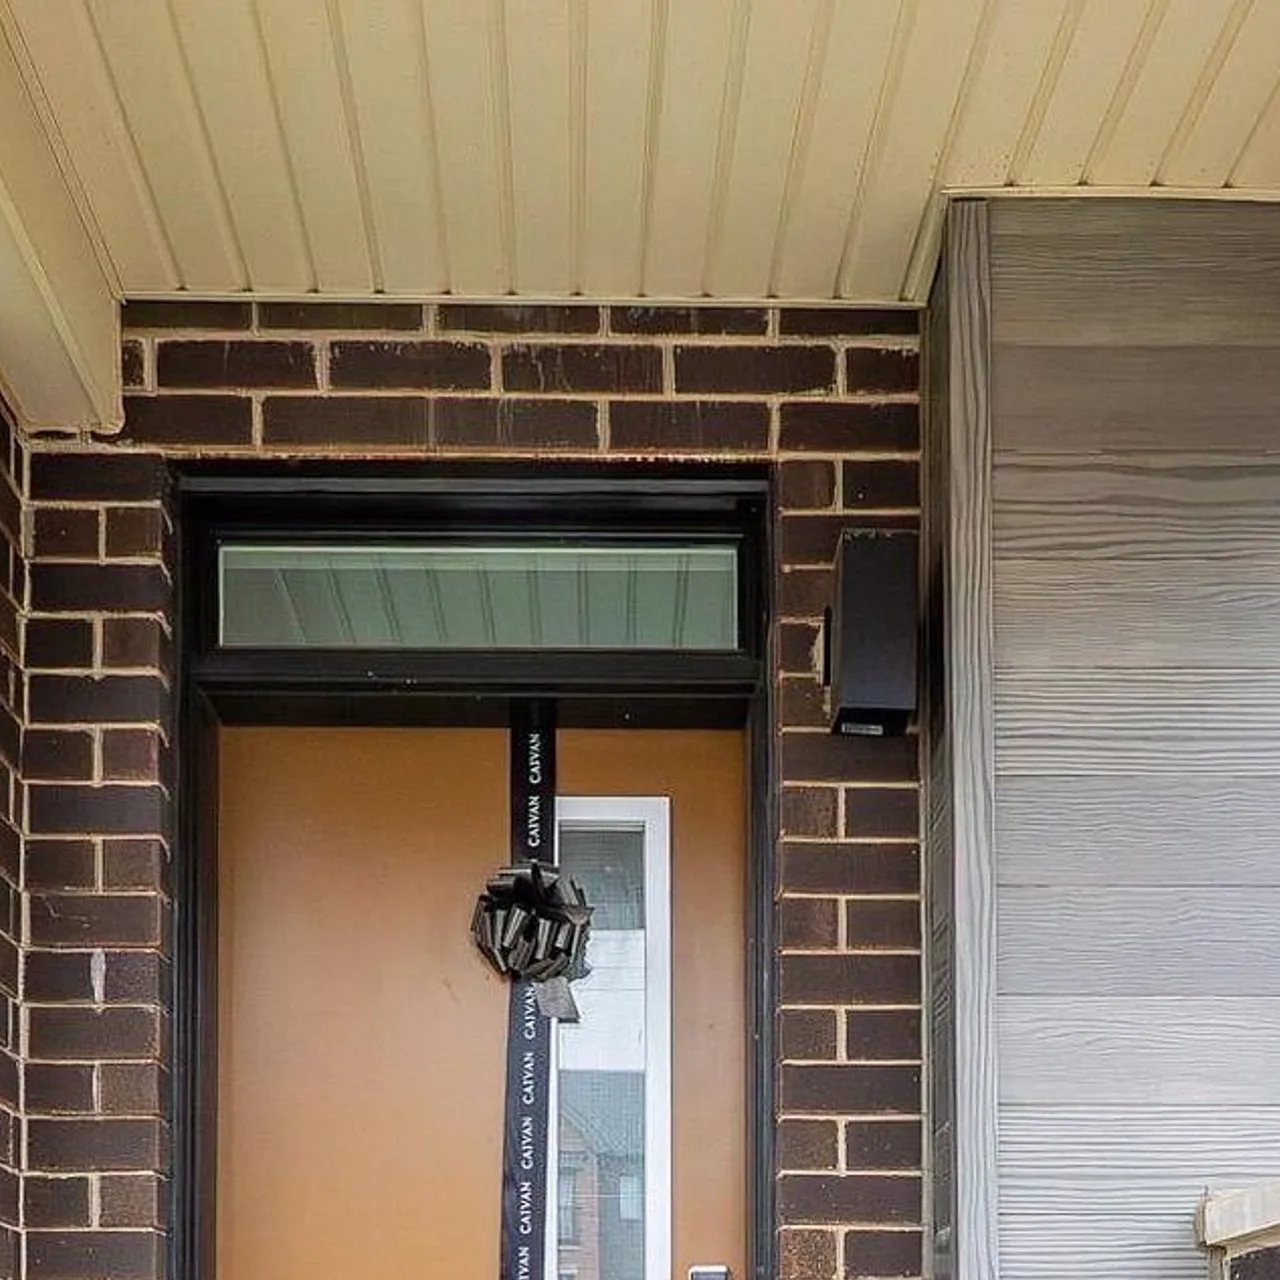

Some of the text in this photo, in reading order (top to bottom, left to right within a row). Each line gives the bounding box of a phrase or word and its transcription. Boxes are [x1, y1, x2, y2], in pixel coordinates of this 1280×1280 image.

[529, 733, 541, 784] CAIVAN
[528, 795, 540, 847] CAIVAN
[522, 1052, 535, 1105] CAIVAN
[521, 1116, 534, 1170] CAIVAN
[519, 1181, 532, 1235] CAIVAN
